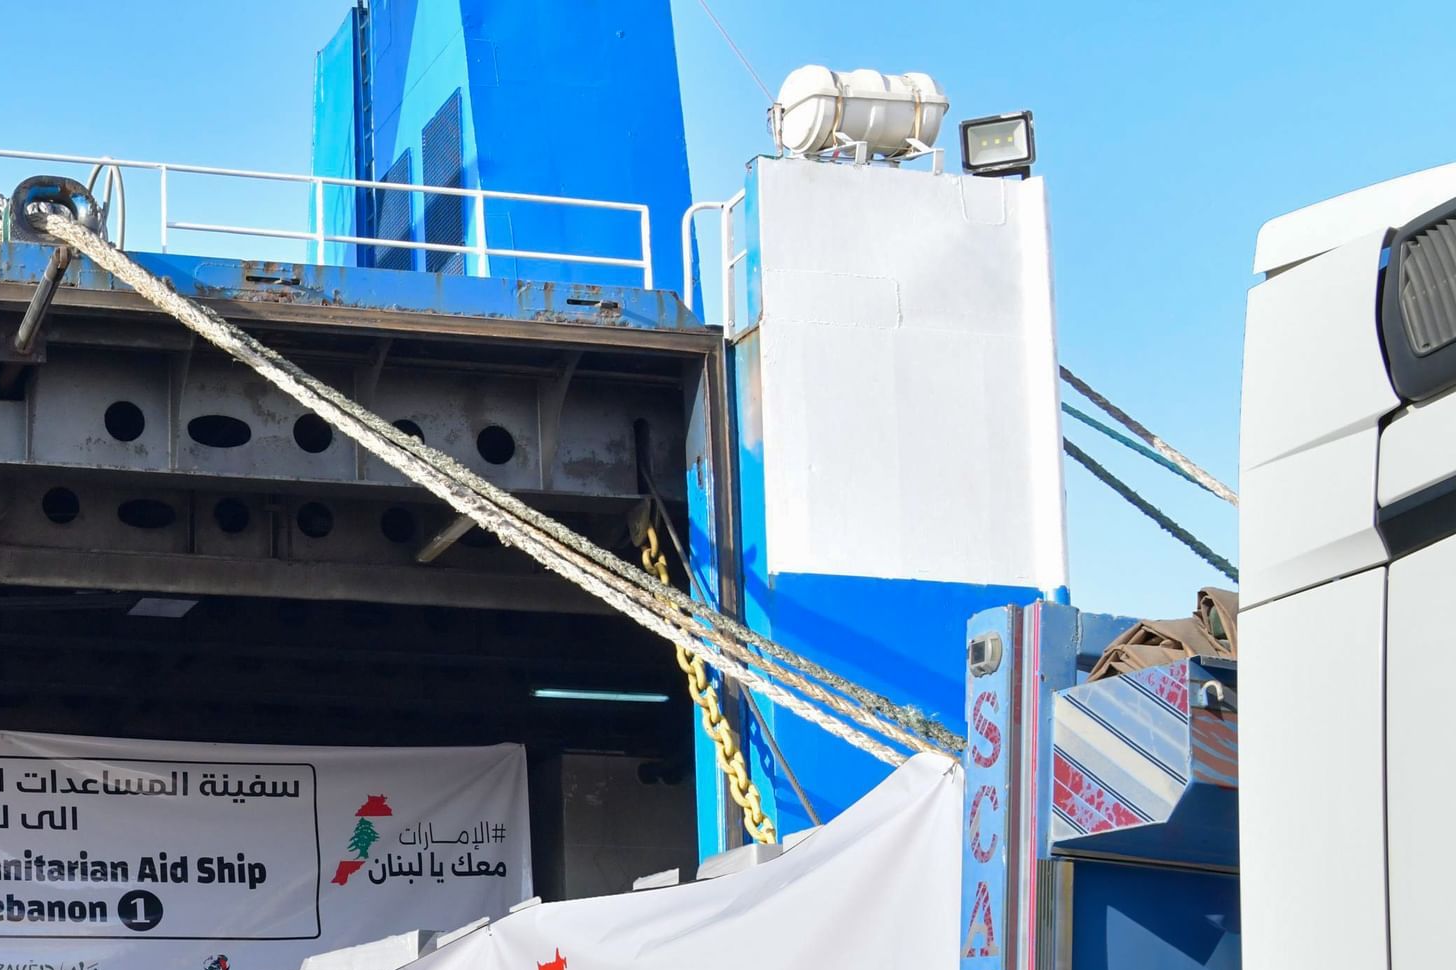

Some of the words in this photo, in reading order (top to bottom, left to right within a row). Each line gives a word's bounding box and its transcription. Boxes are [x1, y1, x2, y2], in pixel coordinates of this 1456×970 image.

[16, 768, 188, 797] المساعدات
[199, 772, 300, 803] سفينة
[136, 851, 189, 884] Aid
[196, 852, 267, 890] Ship
[368, 851, 423, 885] لبنان
[430, 851, 445, 884] يا
[451, 852, 507, 878] معك
